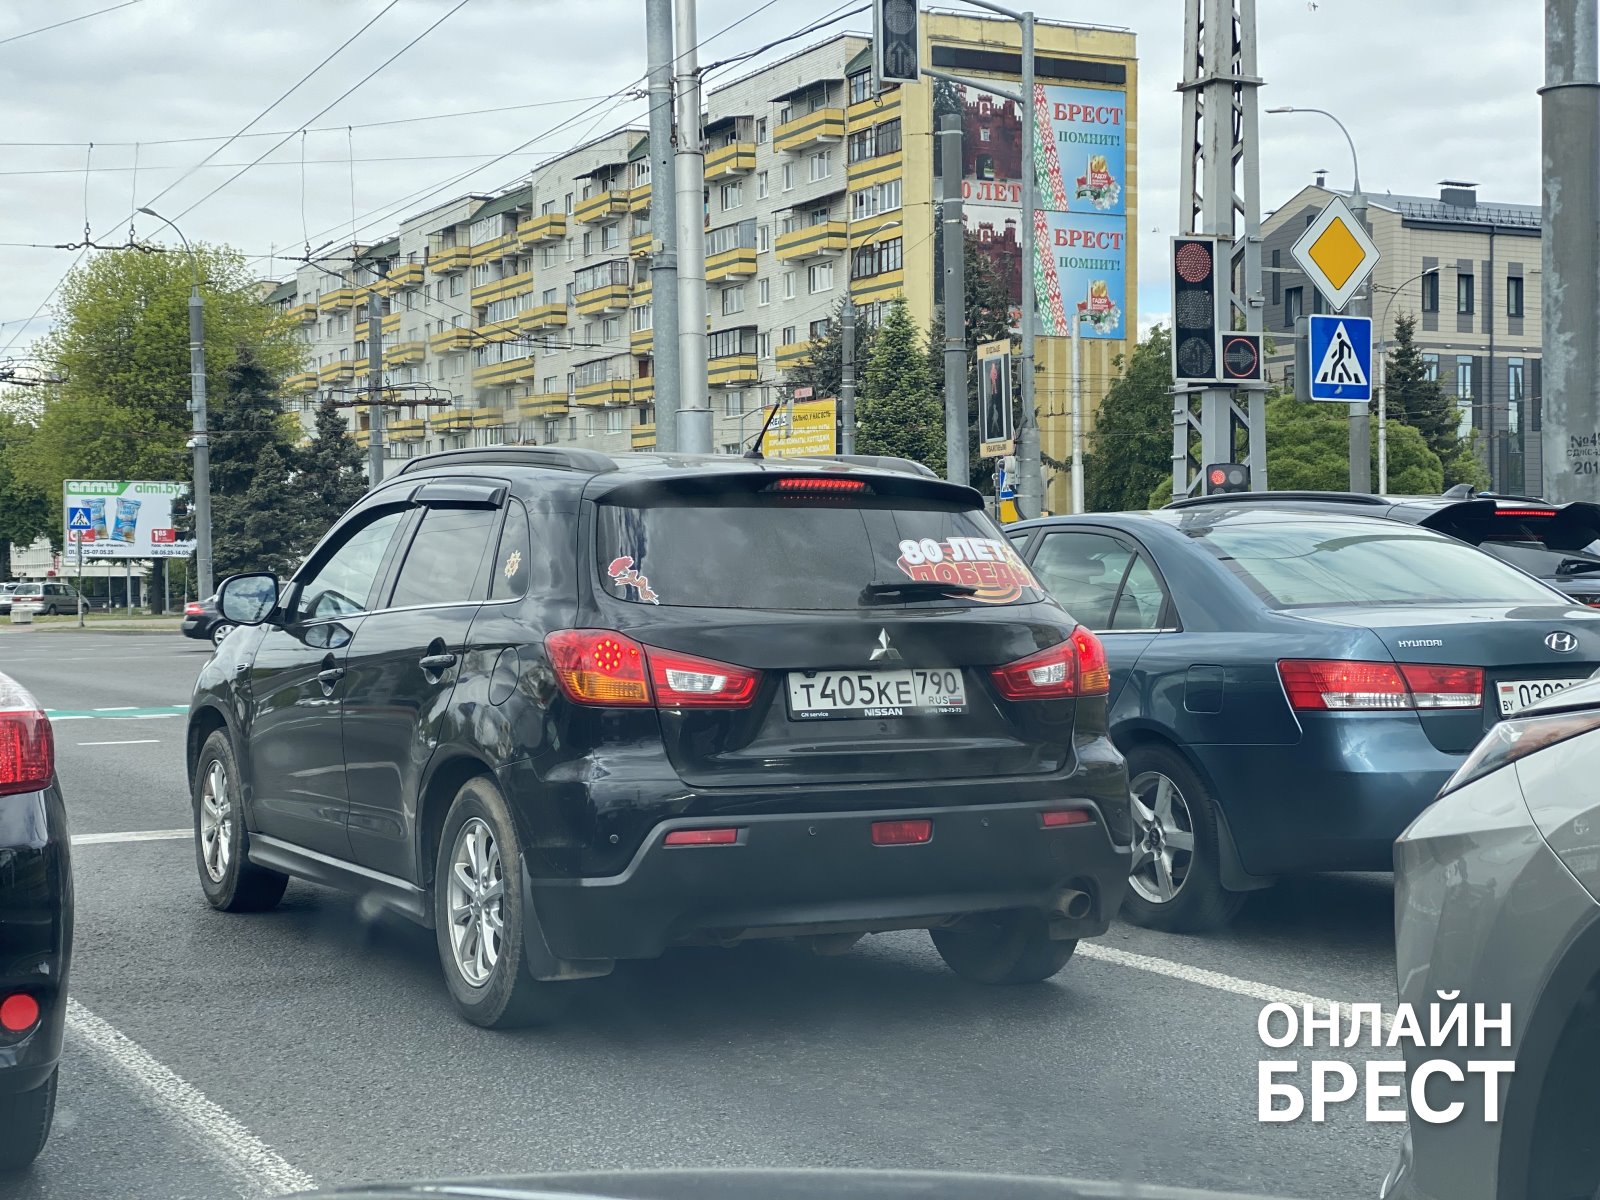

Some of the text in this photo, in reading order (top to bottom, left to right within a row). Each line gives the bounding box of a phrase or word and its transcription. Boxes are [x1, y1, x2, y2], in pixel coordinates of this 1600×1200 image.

[1053, 102, 1123, 125] БРЕСТ
[1059, 131, 1120, 146] ПОМНИТ!
[976, 182, 1022, 203] ЛЕТ
[1054, 228, 1123, 250] БРЕСТ
[1059, 257, 1120, 271] ПОМНИТ!
[1574, 461, 1600, 475] 201
[899, 537, 1006, 564] 80 ЛЕТ
[1398, 639, 1443, 648] HYUNDAI
[800, 671, 958, 708] Т405КЕ 790
[928, 695, 949, 705] RUS
[1503, 700, 1514, 711] BY
[864, 708, 903, 717] NISSAN
